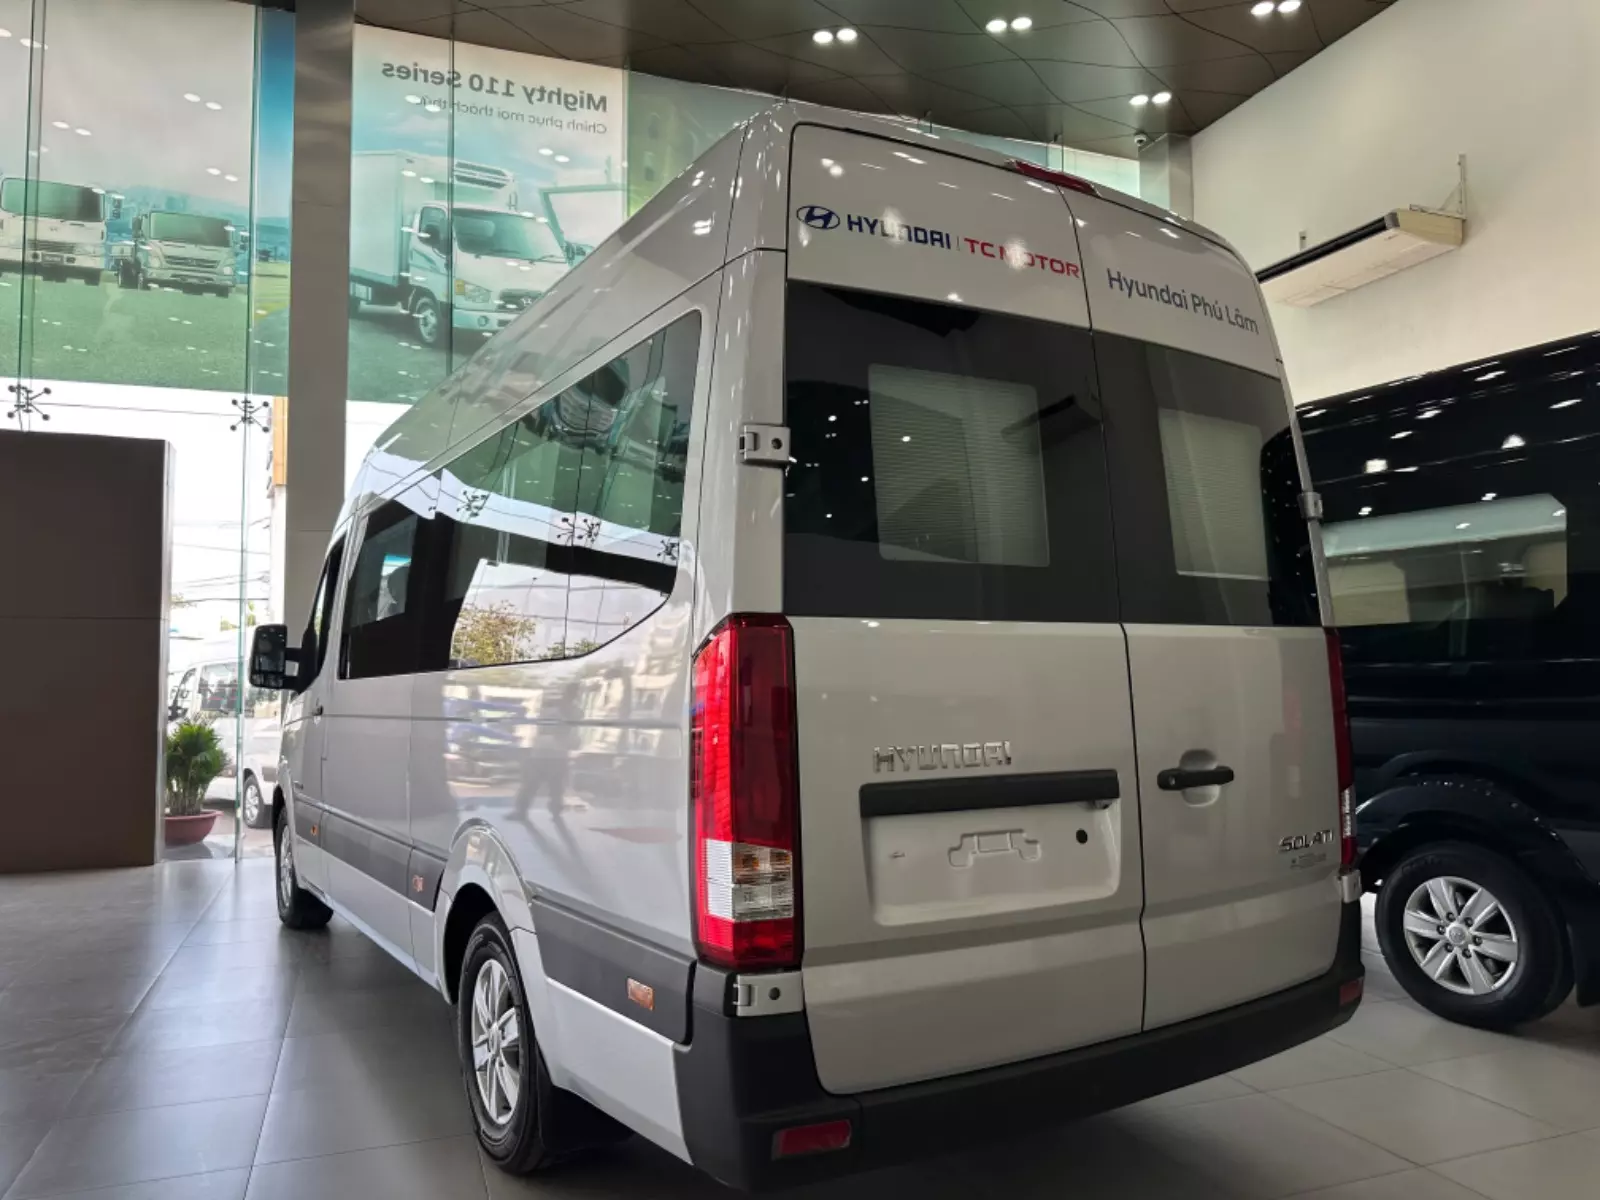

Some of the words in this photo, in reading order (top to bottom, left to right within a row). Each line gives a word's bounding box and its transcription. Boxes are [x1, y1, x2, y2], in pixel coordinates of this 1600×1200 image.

[847, 213, 951, 250] HYUNDAI
[963, 236, 996, 258] TC
[1106, 268, 1189, 310] Hyundai
[1225, 305, 1260, 335] Lâm
[873, 740, 1012, 773] HYUNDAI
[1278, 829, 1334, 852] SOLATI
